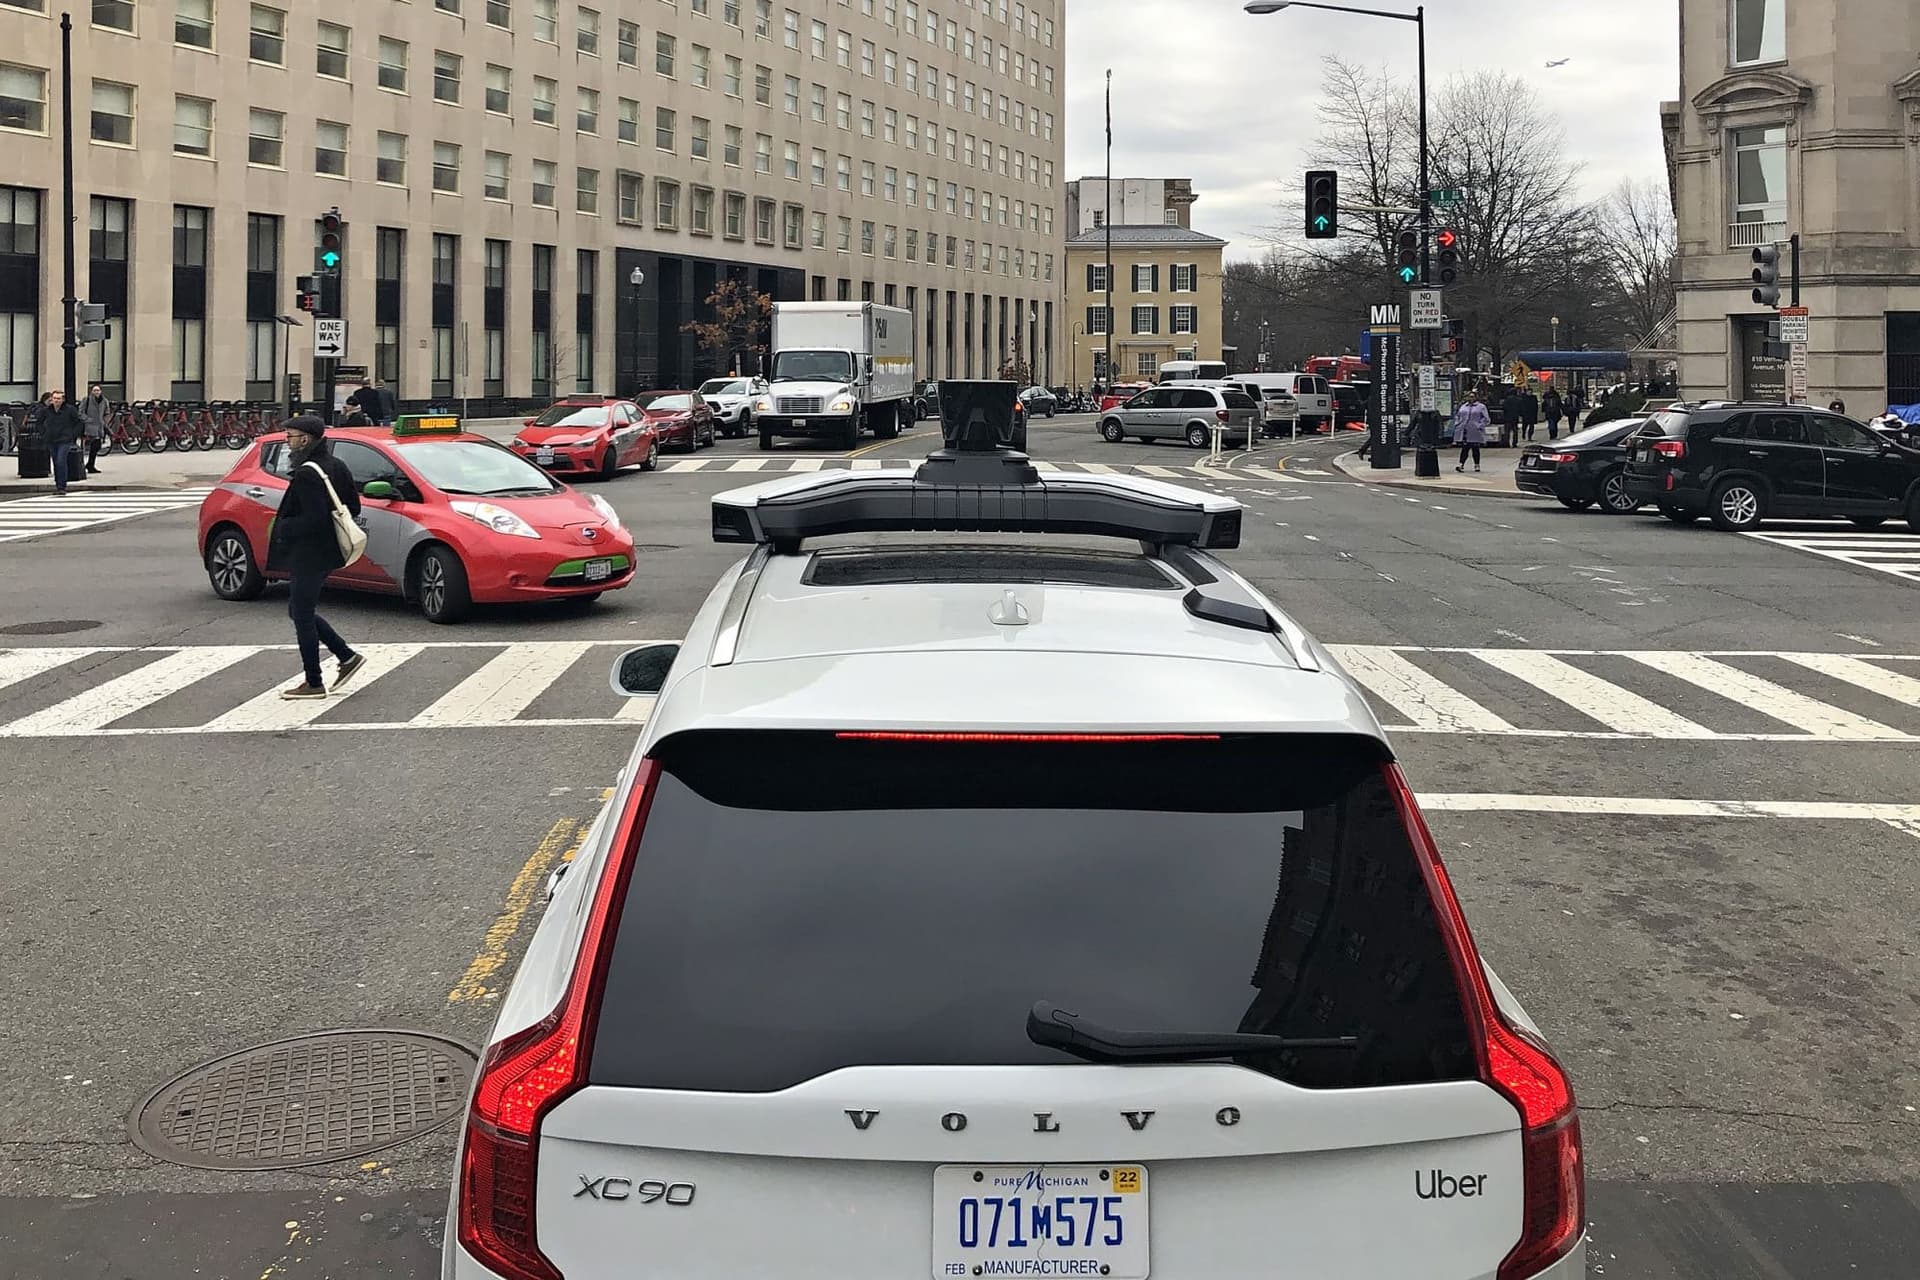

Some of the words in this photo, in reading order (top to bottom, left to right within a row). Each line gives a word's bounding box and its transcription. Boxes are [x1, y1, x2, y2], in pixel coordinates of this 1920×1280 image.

[1420, 292, 1431, 300] NO
[319, 332, 341, 341] WAY
[320, 322, 341, 331] ONE
[1380, 384, 1388, 412] Square
[844, 1105, 1241, 1133] VOLVO
[994, 1177, 1022, 1187] PURE
[1013, 1170, 1089, 1194] MICHIGAN
[1119, 1171, 1138, 1183] 22
[1415, 1169, 1488, 1199] Uber
[959, 1197, 1123, 1248] 071M575
[945, 1262, 966, 1275] FEB
[984, 1259, 1098, 1275] MANUFACTURER
